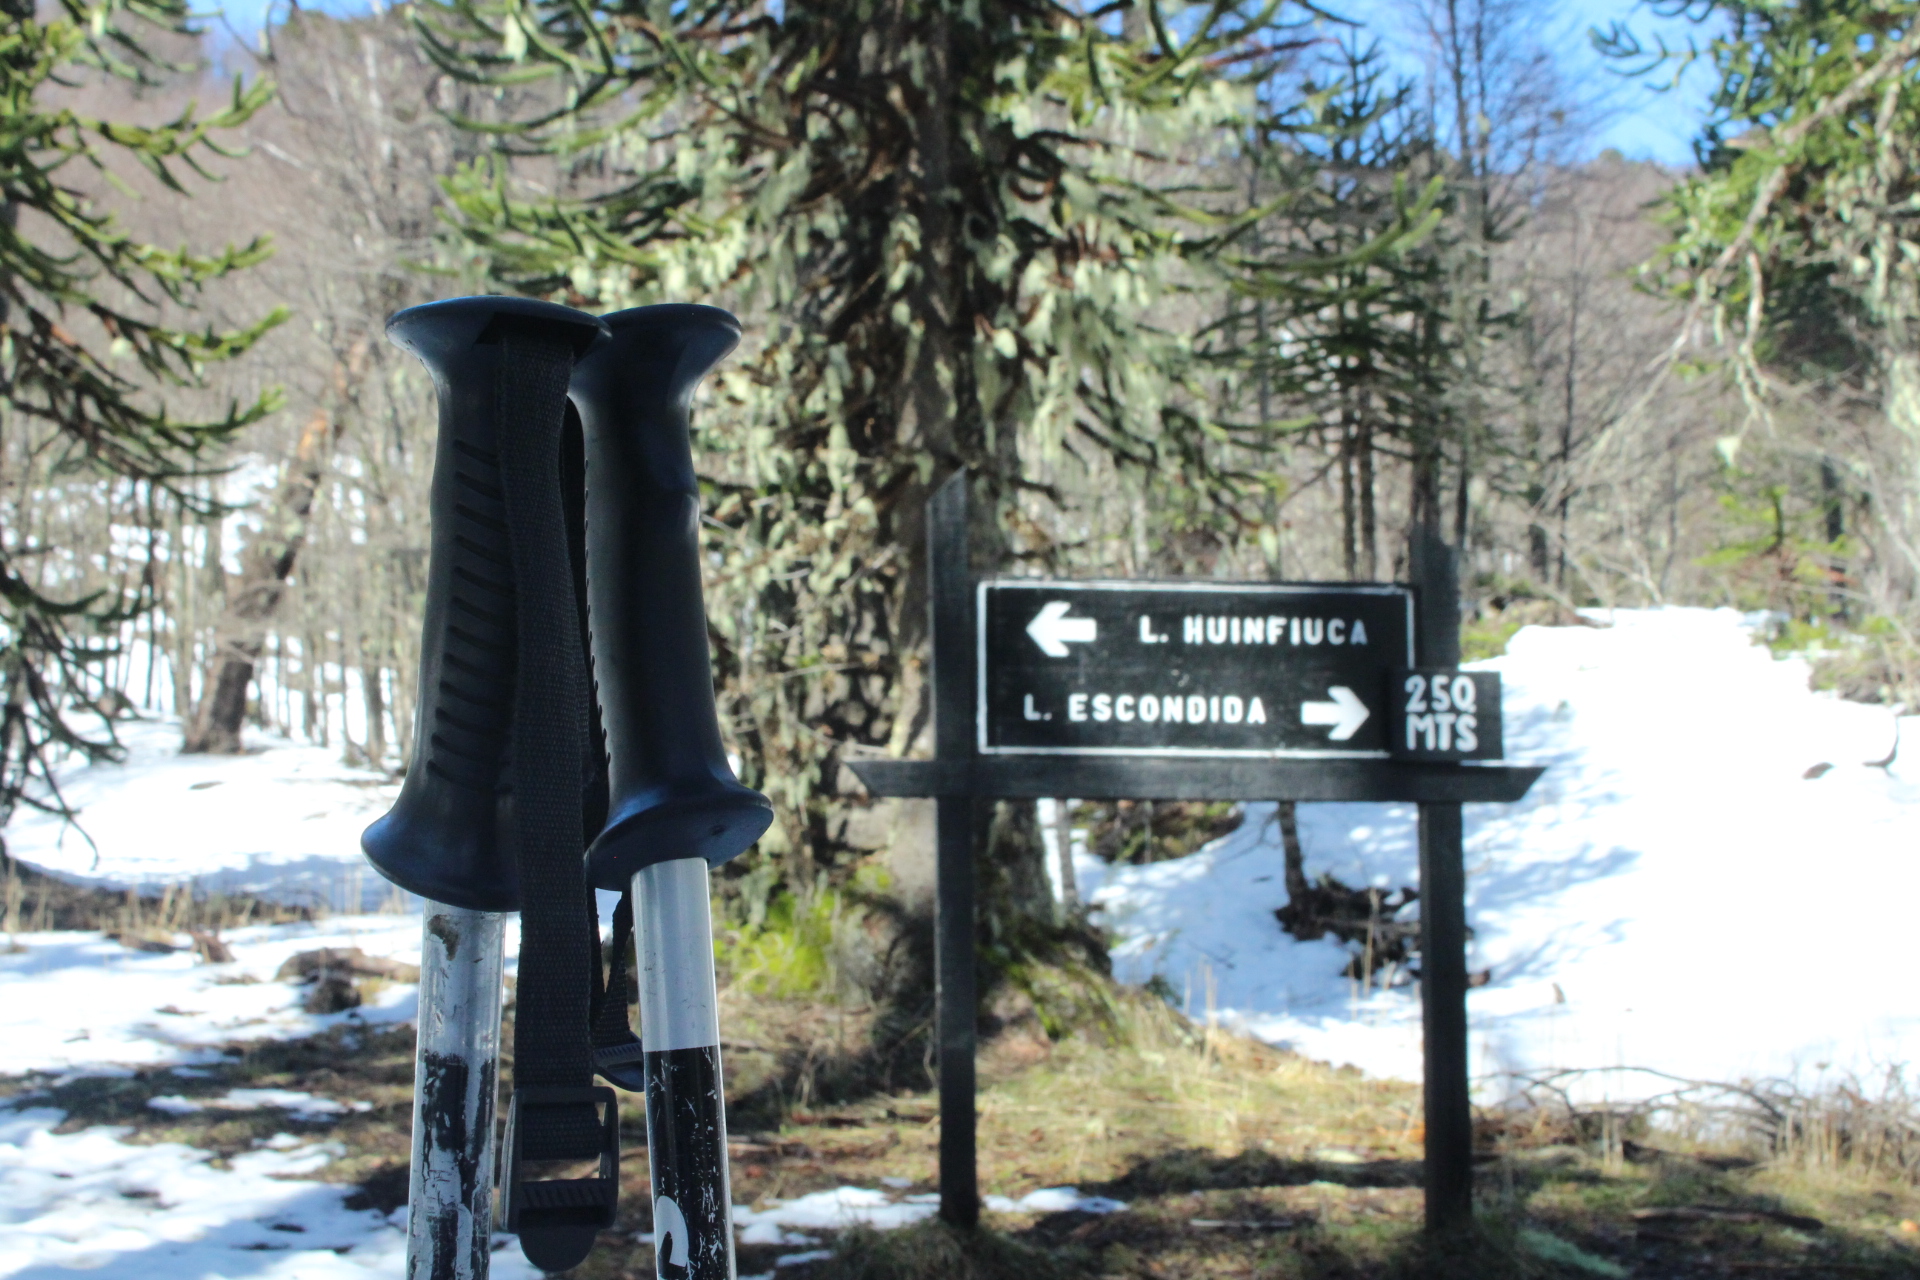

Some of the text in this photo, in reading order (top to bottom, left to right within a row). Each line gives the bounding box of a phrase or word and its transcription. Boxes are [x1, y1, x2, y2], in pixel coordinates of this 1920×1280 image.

[1139, 614, 1368, 646] L. HUINFIUCA
[1023, 692, 1267, 725] L. ESCONDIDA
[1405, 712, 1478, 752] MTS
